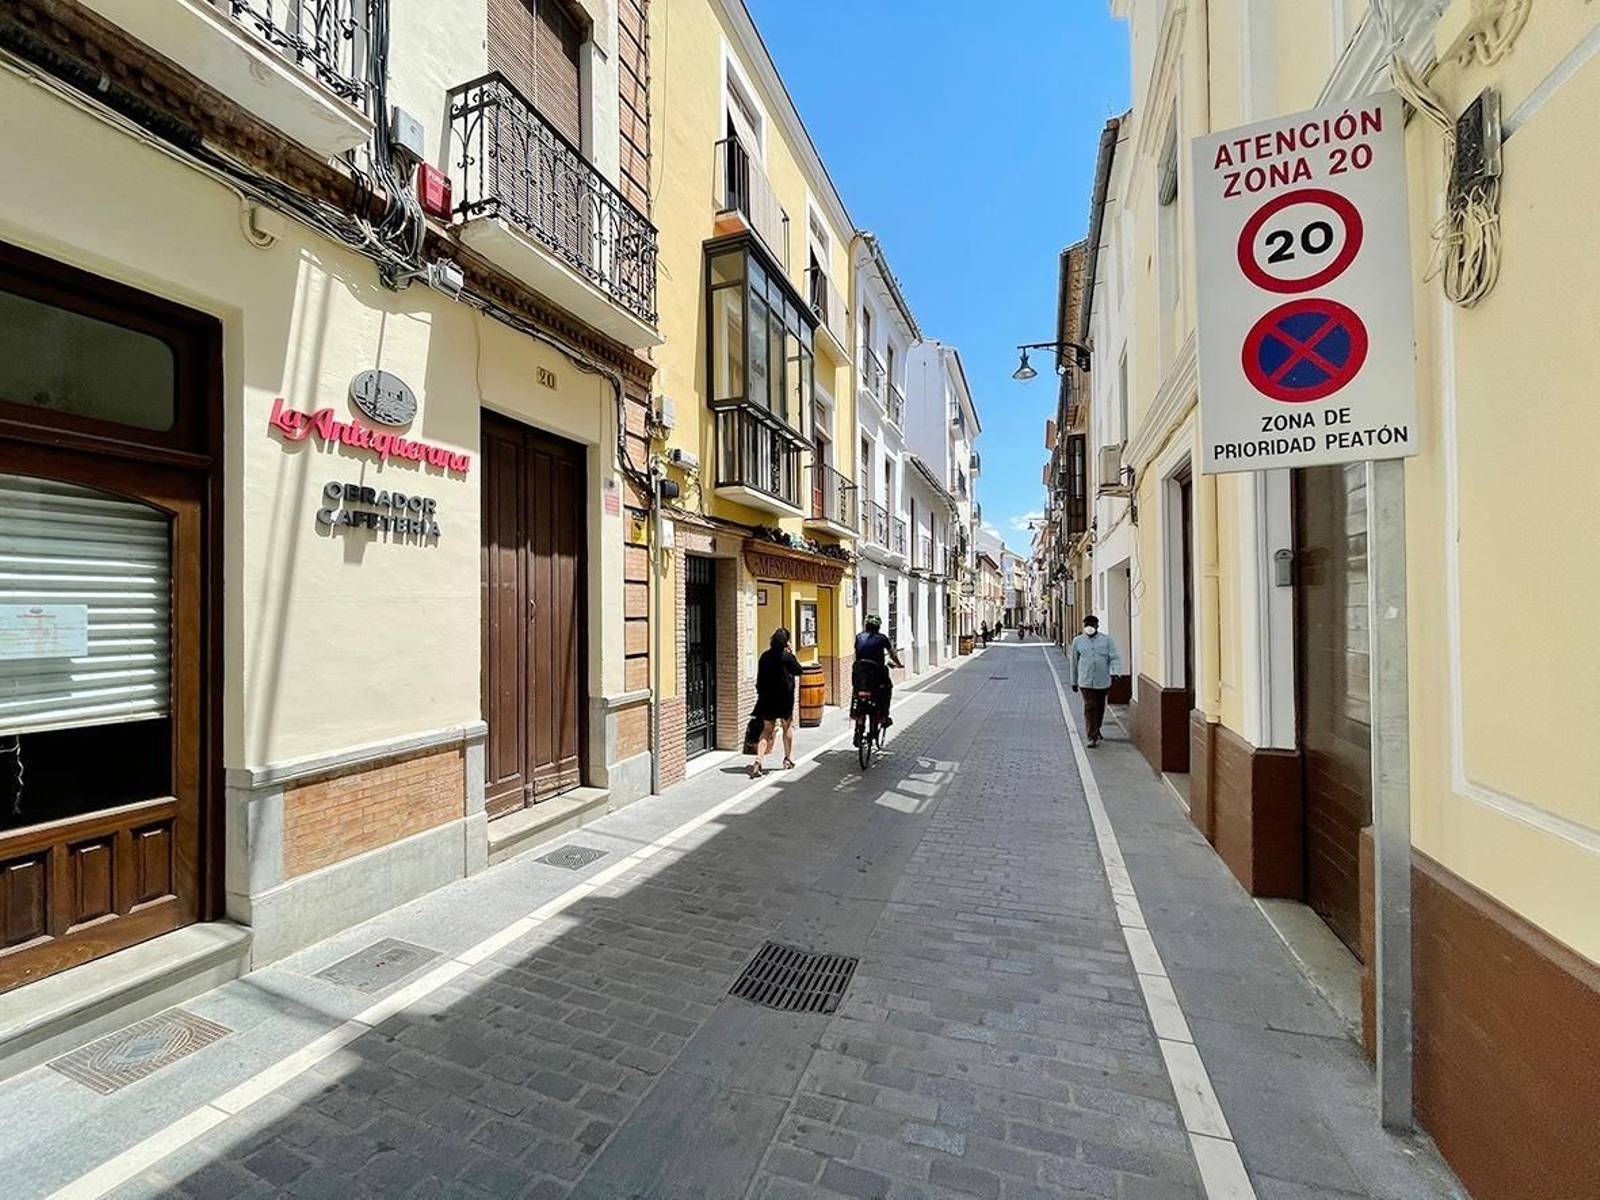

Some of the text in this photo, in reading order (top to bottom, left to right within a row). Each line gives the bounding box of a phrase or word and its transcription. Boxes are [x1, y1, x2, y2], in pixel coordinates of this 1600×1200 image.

[1214, 108, 1383, 170] ATENCIÓN
[1223, 143, 1373, 198] ZONA 20
[1264, 221, 1334, 264] 20
[539, 369, 555, 388] 20
[269, 398, 471, 473] La Antequerana
[1261, 408, 1351, 433] ZONA DE
[1214, 425, 1408, 460] PRIORIDAD PEATÓN
[324, 481, 437, 514] OBRADOR
